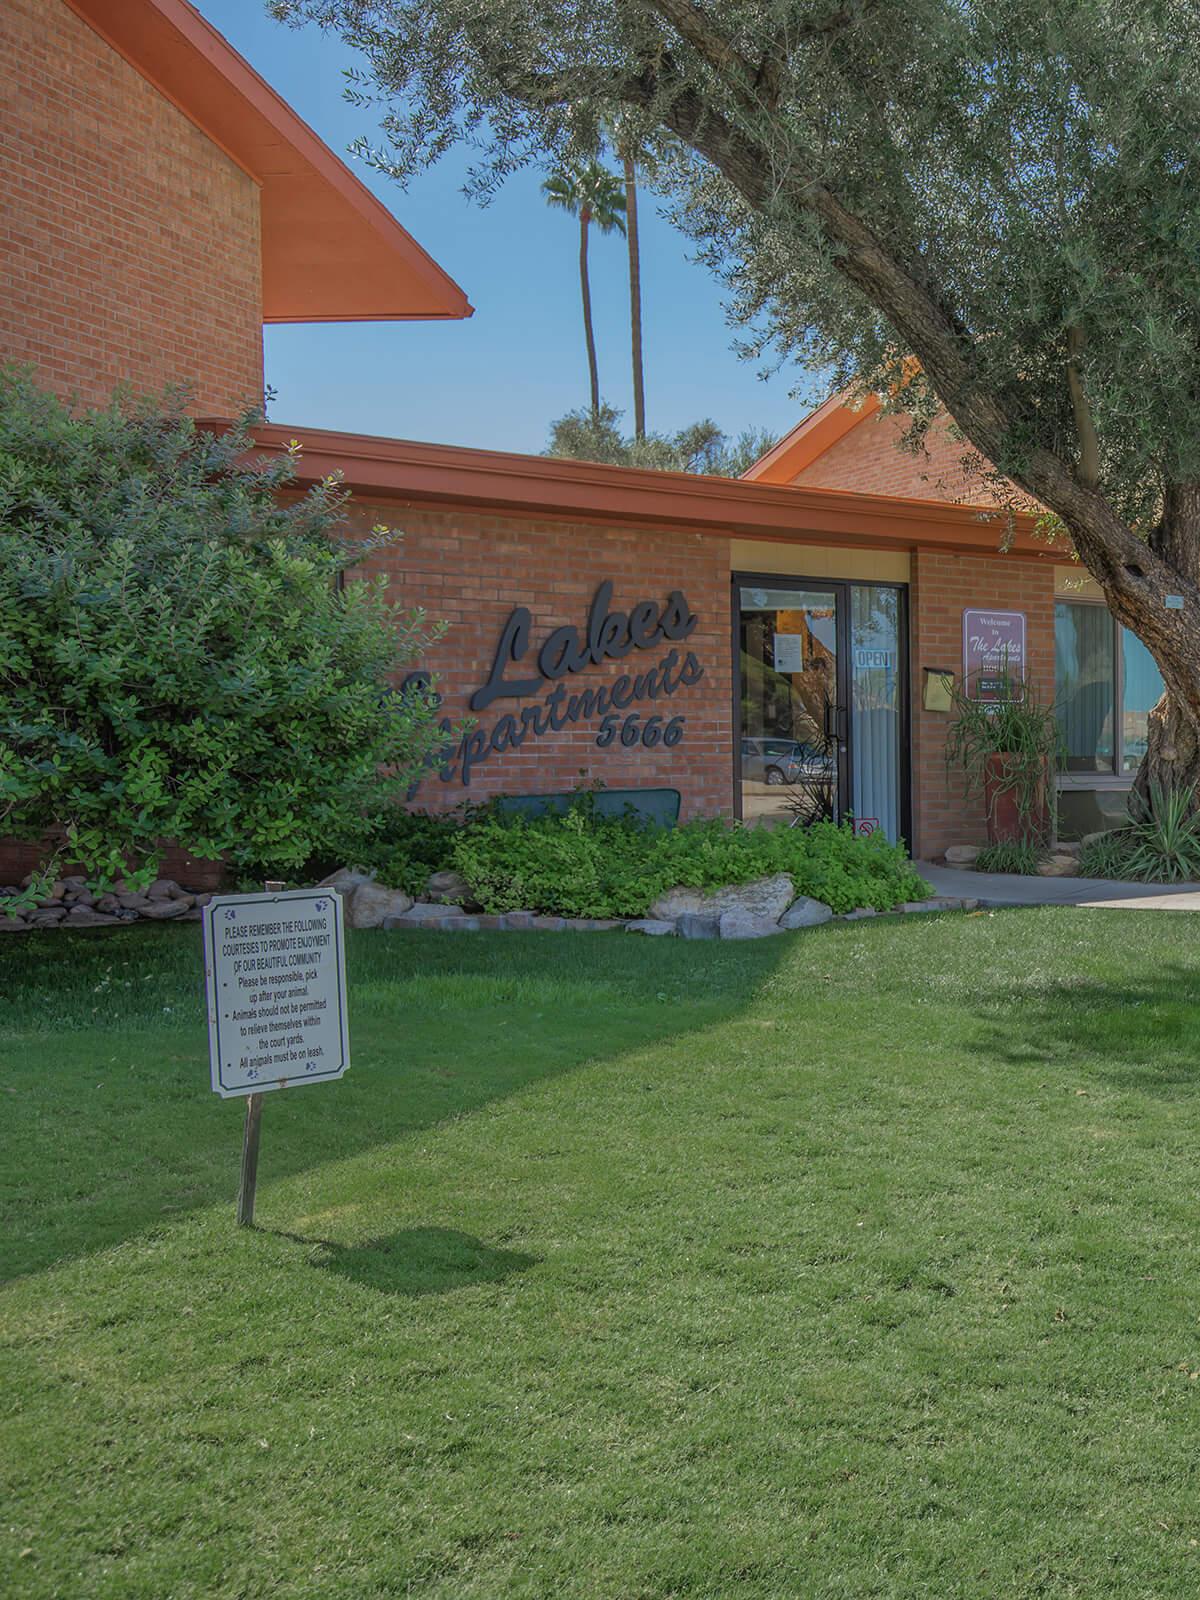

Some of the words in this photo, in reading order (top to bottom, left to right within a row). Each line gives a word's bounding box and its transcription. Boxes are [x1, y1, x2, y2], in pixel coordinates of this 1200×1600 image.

[979, 617, 1010, 627] Welcome
[470, 579, 698, 711] Lakes
[970, 636, 988, 652] The
[858, 651, 888, 667] OPEN
[596, 713, 685, 747] 5666
[225, 925, 248, 940] PLEASE
[249, 923, 281, 937] REMEMBER
[282, 922, 293, 934] THE
[294, 918, 327, 933] FOLLOWING
[223, 941, 259, 956] COURTESIES
[260, 940, 268, 953] TO
[269, 938, 297, 952] PROMOTE
[297, 934, 331, 949] ENJOYMENT
[234, 960, 242, 973] OF
[243, 959, 256, 972] OUR
[257, 956, 288, 970] BEAUTIFUL
[289, 952, 322, 967] COMMUNITY
[238, 976, 259, 989] Please
[260, 974, 268, 985] be
[305, 968, 318, 983] pick
[249, 994, 258, 1004] up
[259, 990, 272, 1002] after
[273, 990, 287, 1003] your
[232, 1008, 257, 1021] Animals
[258, 1005, 279, 1018] should
[280, 1004, 290, 1016] not
[291, 1003, 298, 1014] be
[299, 999, 327, 1013] permitted
[240, 1026, 247, 1037] to
[247, 1023, 268, 1035] relieve
[269, 1019, 303, 1033] themselves
[303, 1016, 321, 1028] within
[258, 1038, 269, 1050] the
[270, 1035, 286, 1048] court
[240, 1057, 249, 1069] All
[249, 1053, 272, 1067] animals
[273, 1051, 289, 1063] must
[290, 1050, 298, 1060] be
[298, 1049, 306, 1059] on
